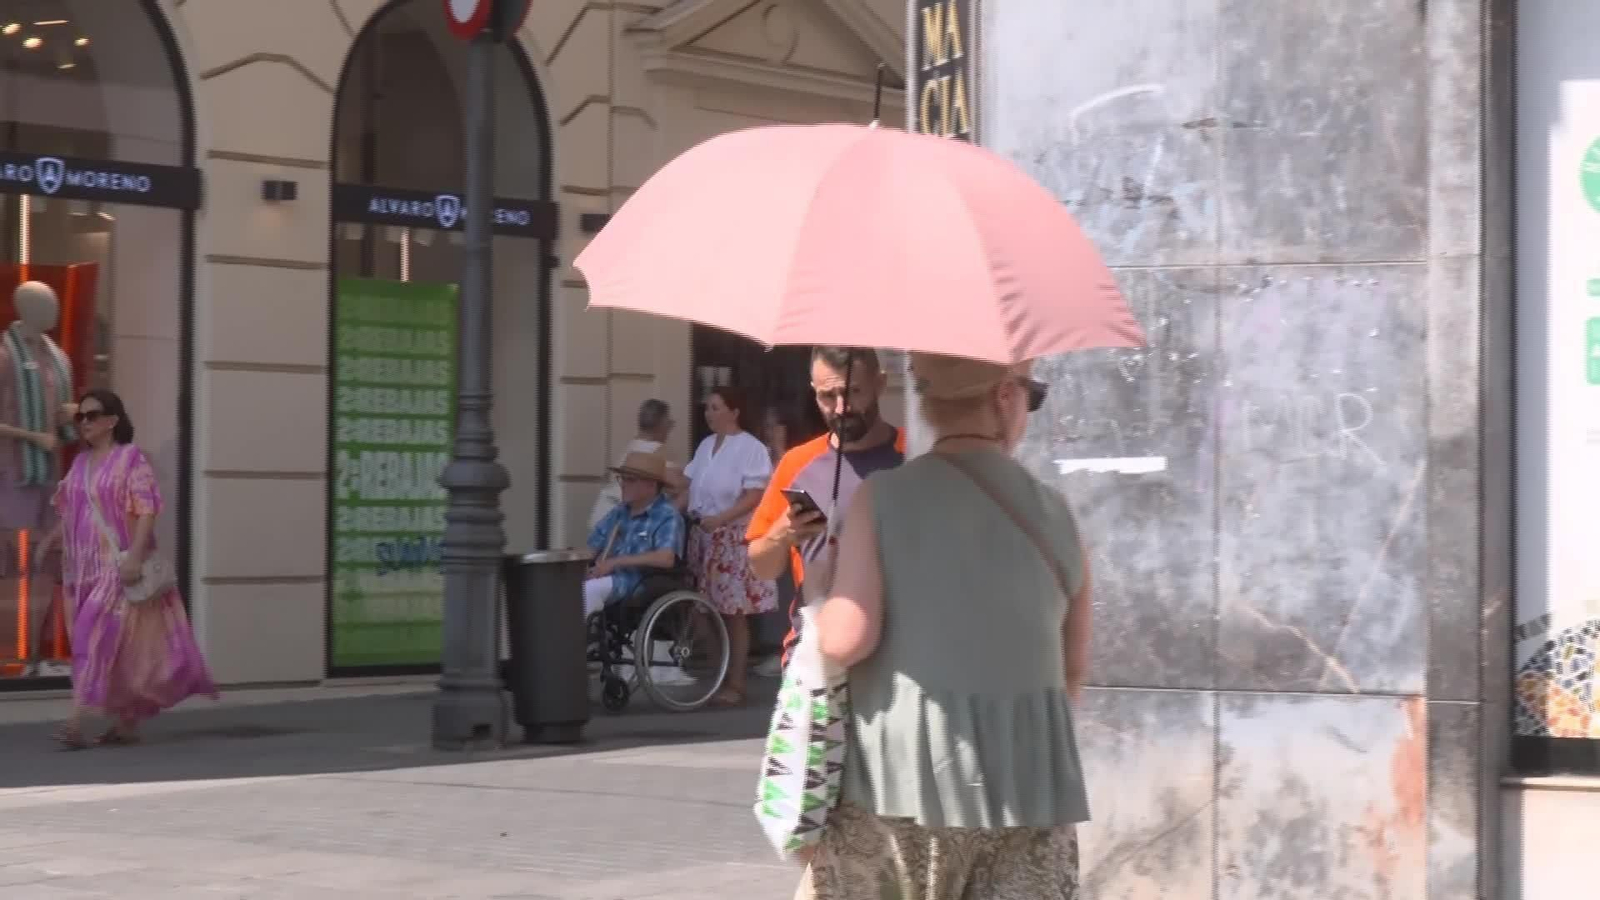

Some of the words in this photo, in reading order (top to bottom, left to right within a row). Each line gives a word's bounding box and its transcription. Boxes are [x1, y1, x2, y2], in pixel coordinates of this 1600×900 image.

[0, 163, 35, 182] RO
[66, 170, 152, 193] MORENO
[369, 197, 435, 218] ALVARO
[359, 419, 449, 445] REBAJAS
